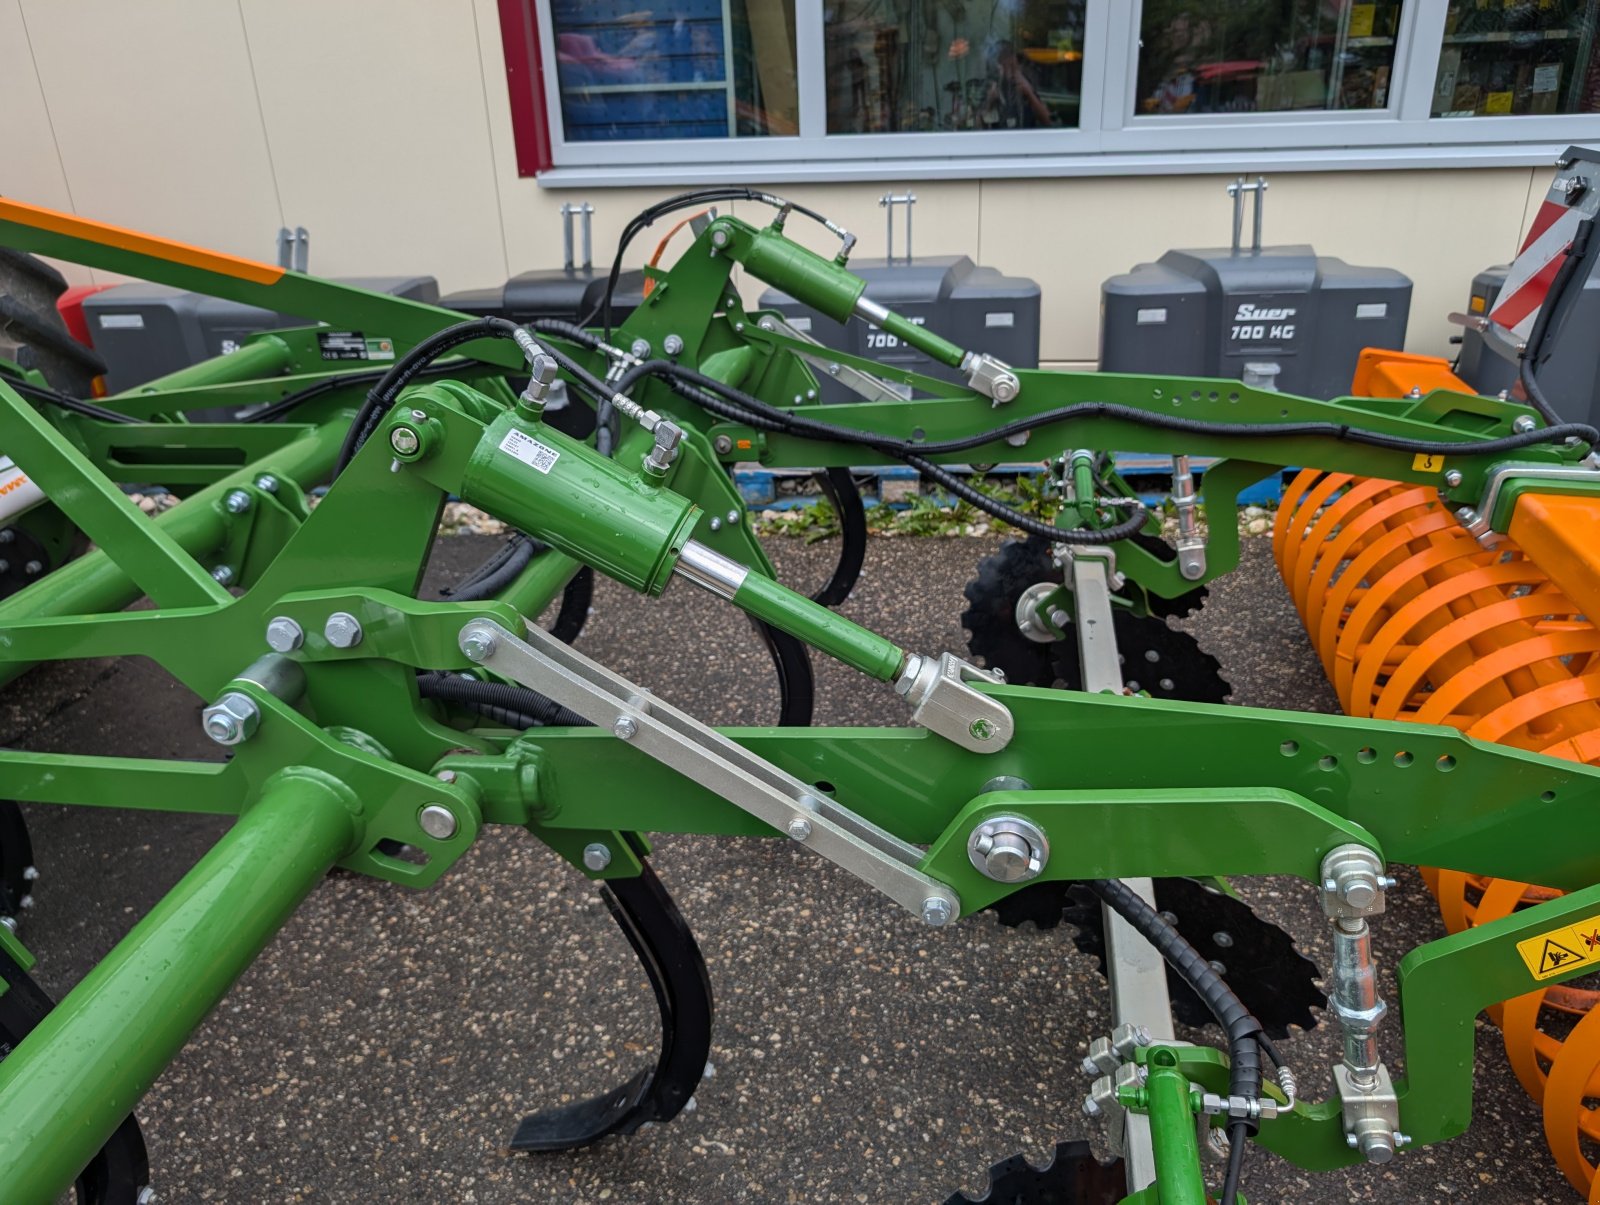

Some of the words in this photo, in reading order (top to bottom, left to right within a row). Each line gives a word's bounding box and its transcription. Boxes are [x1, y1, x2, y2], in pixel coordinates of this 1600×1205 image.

[1235, 304, 1296, 320] Suer
[1231, 325, 1265, 339] 700
[1269, 325, 1295, 339] KG
[867, 333, 899, 349] 700
[512, 431, 558, 457] AMAZONE
